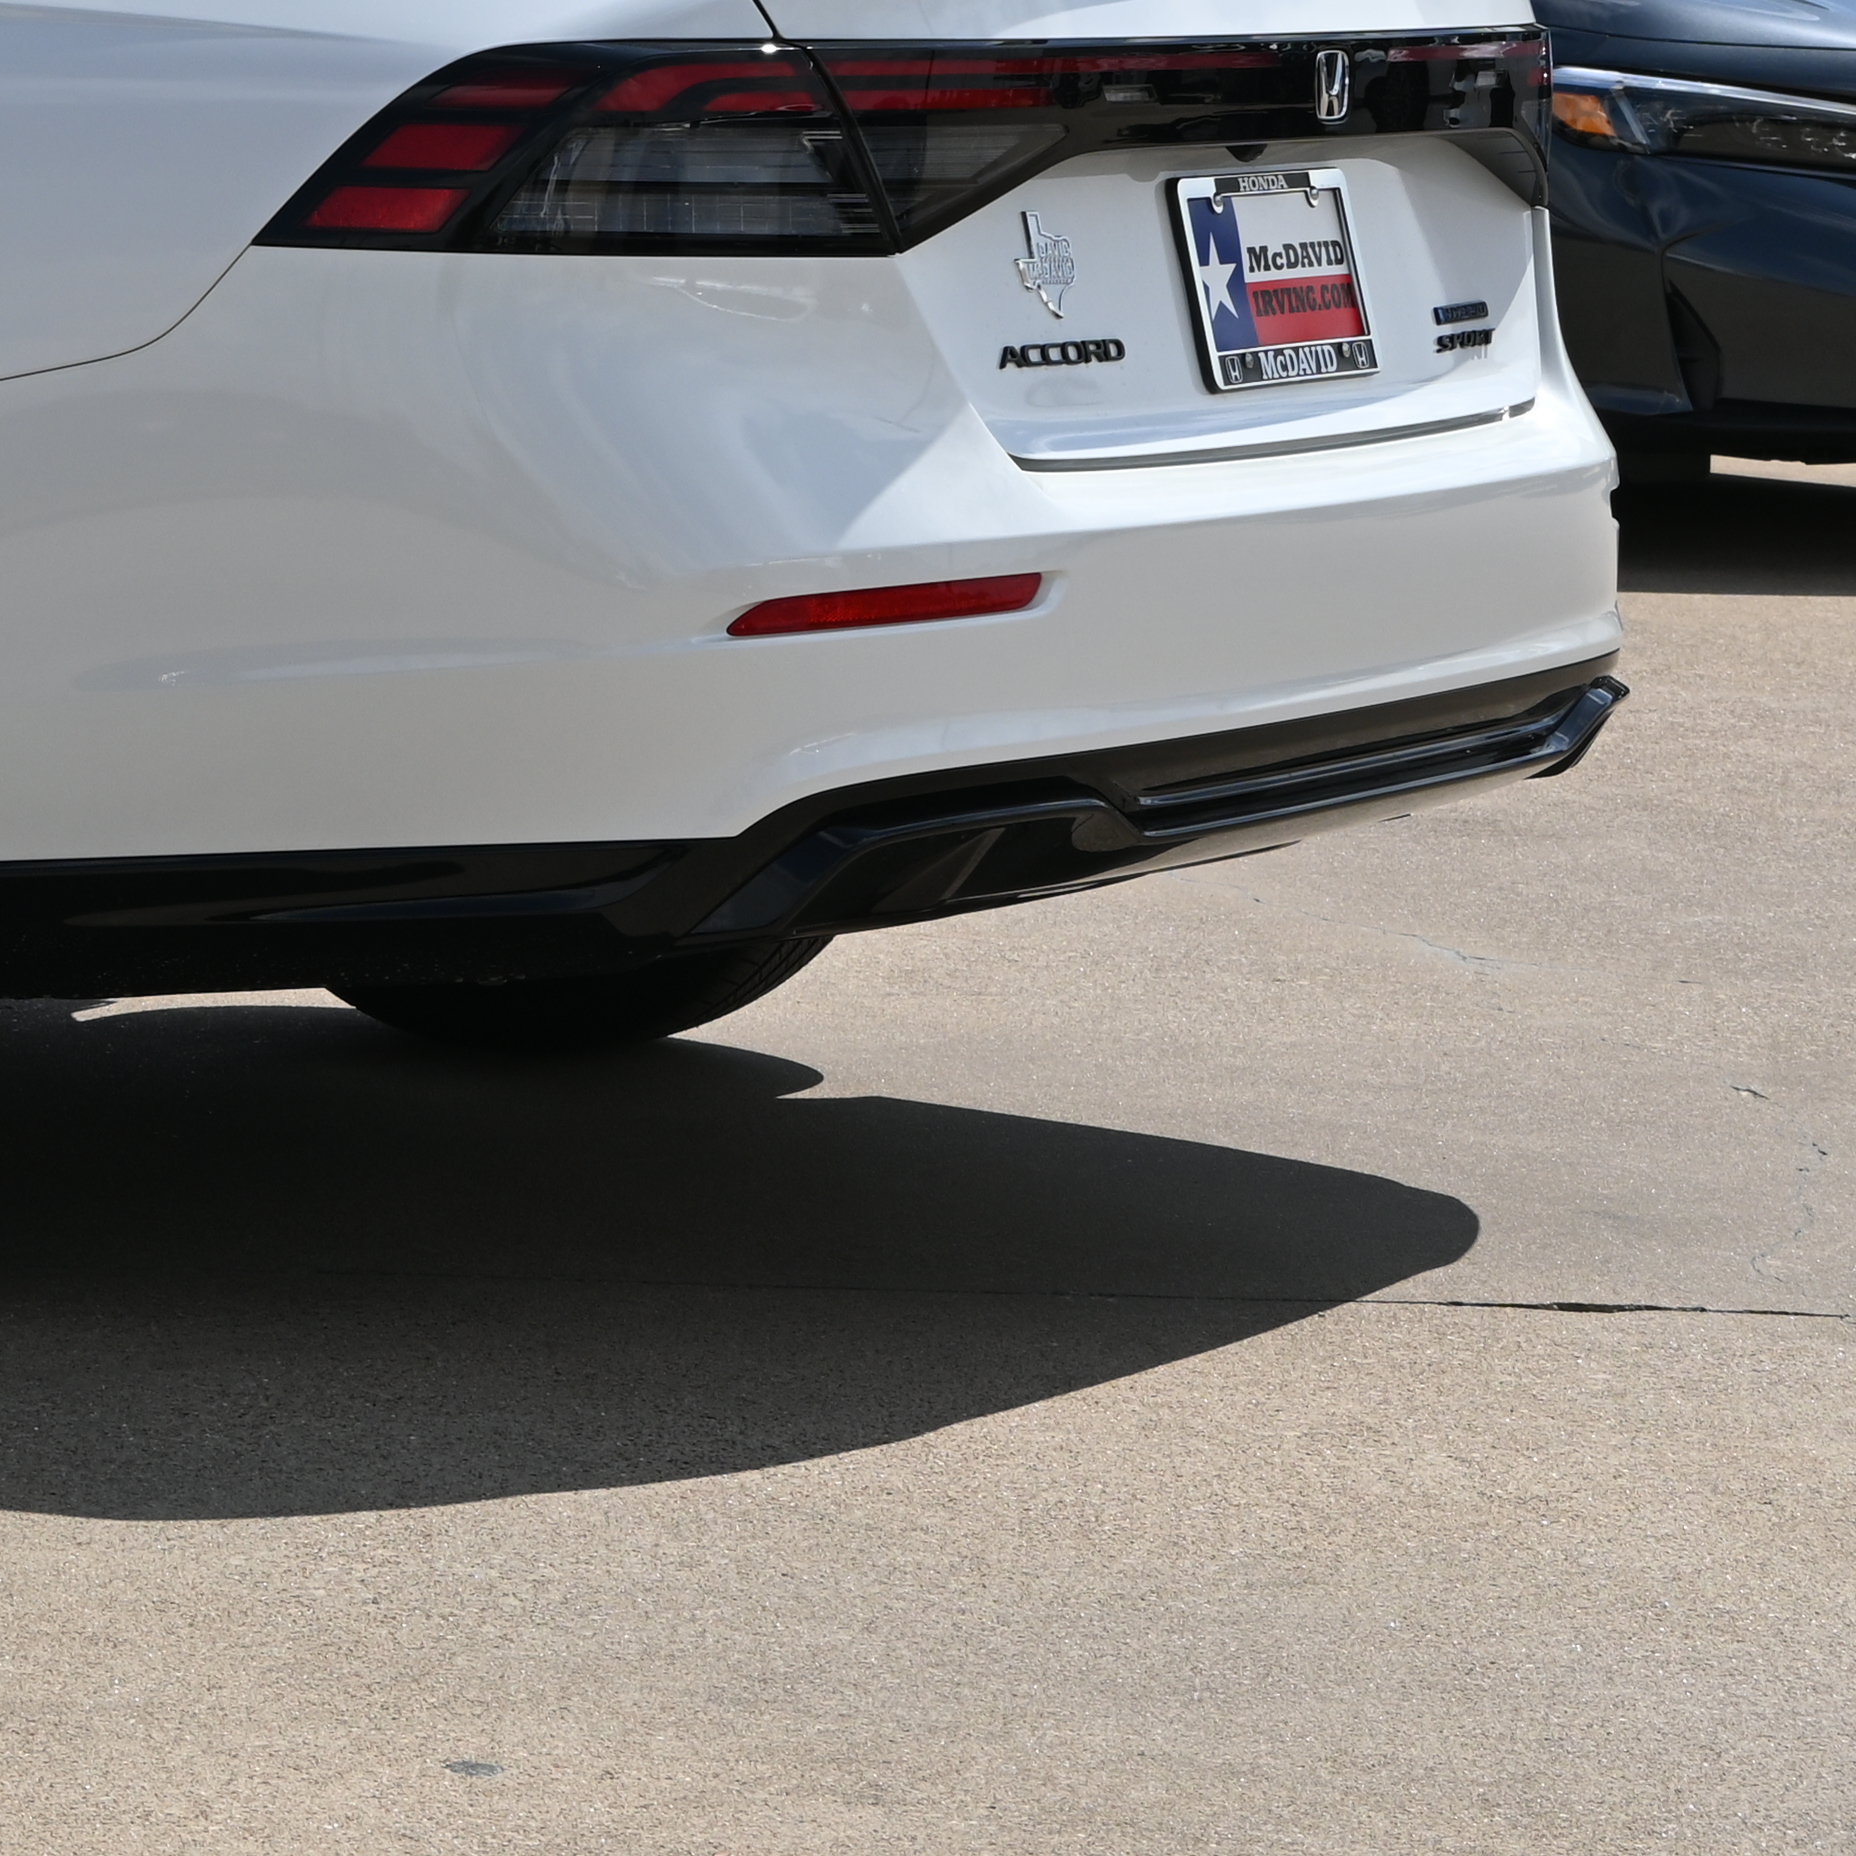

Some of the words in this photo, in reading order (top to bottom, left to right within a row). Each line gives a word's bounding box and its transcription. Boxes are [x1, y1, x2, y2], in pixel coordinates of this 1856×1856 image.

[1238, 174, 1289, 192] HONDA
[1247, 240, 1346, 273] McDAVID
[1253, 282, 1358, 317] IRVING.COM
[999, 338, 1126, 370] ACCORD
[1436, 328, 1496, 354] SPORT
[1258, 344, 1338, 380] McDAVID
